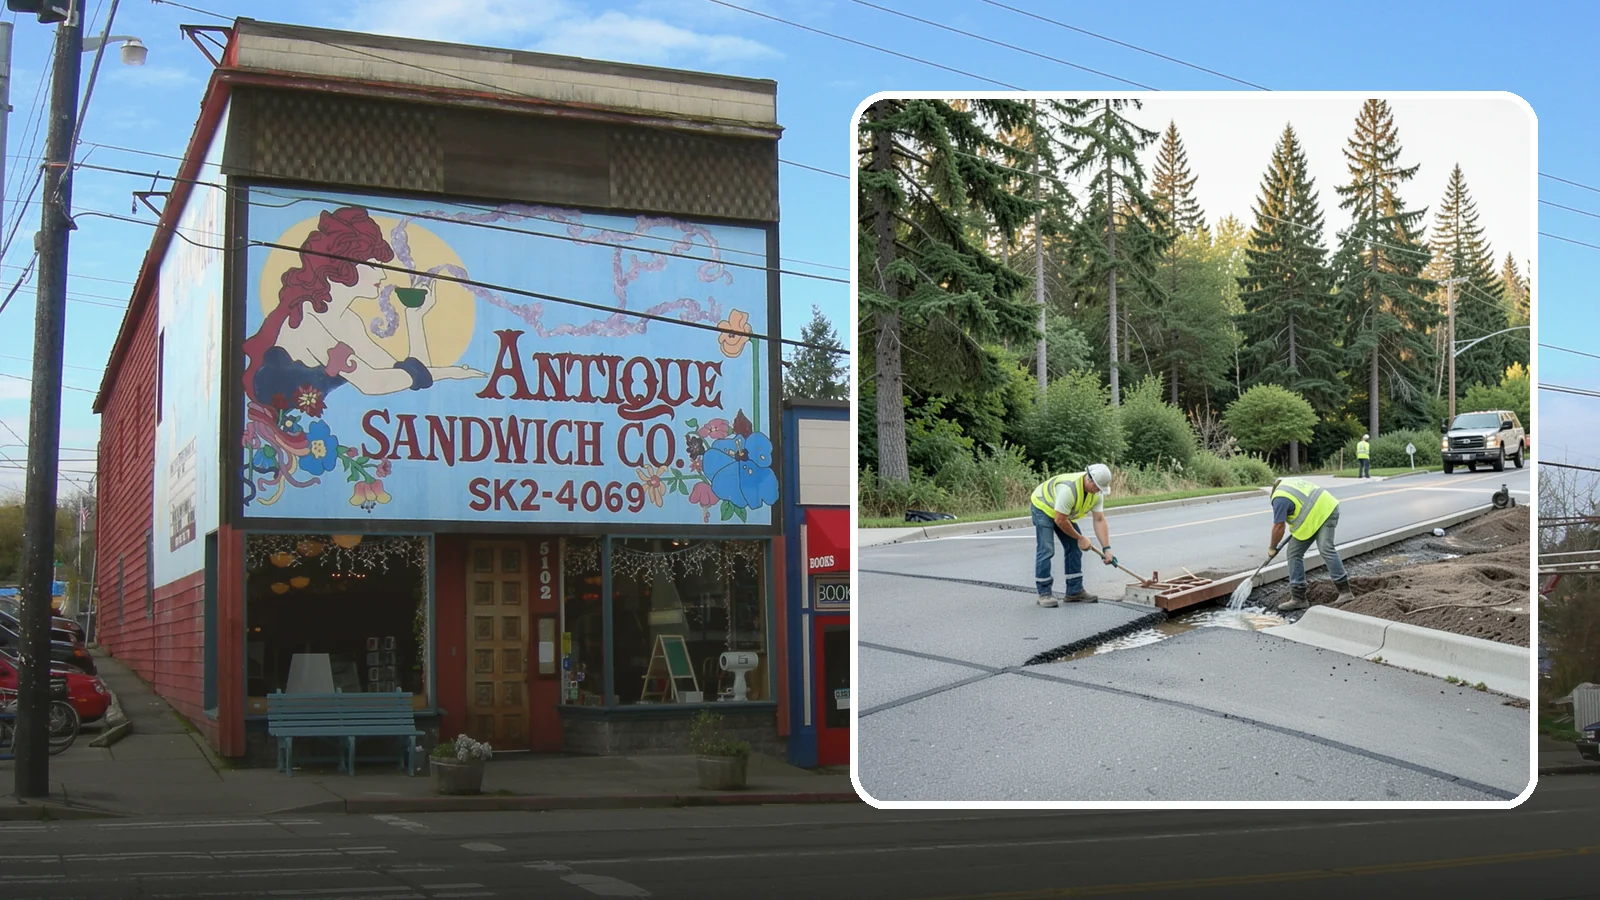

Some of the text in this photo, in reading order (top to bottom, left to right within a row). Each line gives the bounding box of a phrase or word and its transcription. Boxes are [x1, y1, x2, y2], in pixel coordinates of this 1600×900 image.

[477, 329, 724, 421] ANTIQUE
[361, 408, 686, 469] SANDWICH CO.
[468, 477, 646, 514] SK2-4069
[539, 541, 552, 600] 5102
[809, 555, 835, 569] BOOKS
